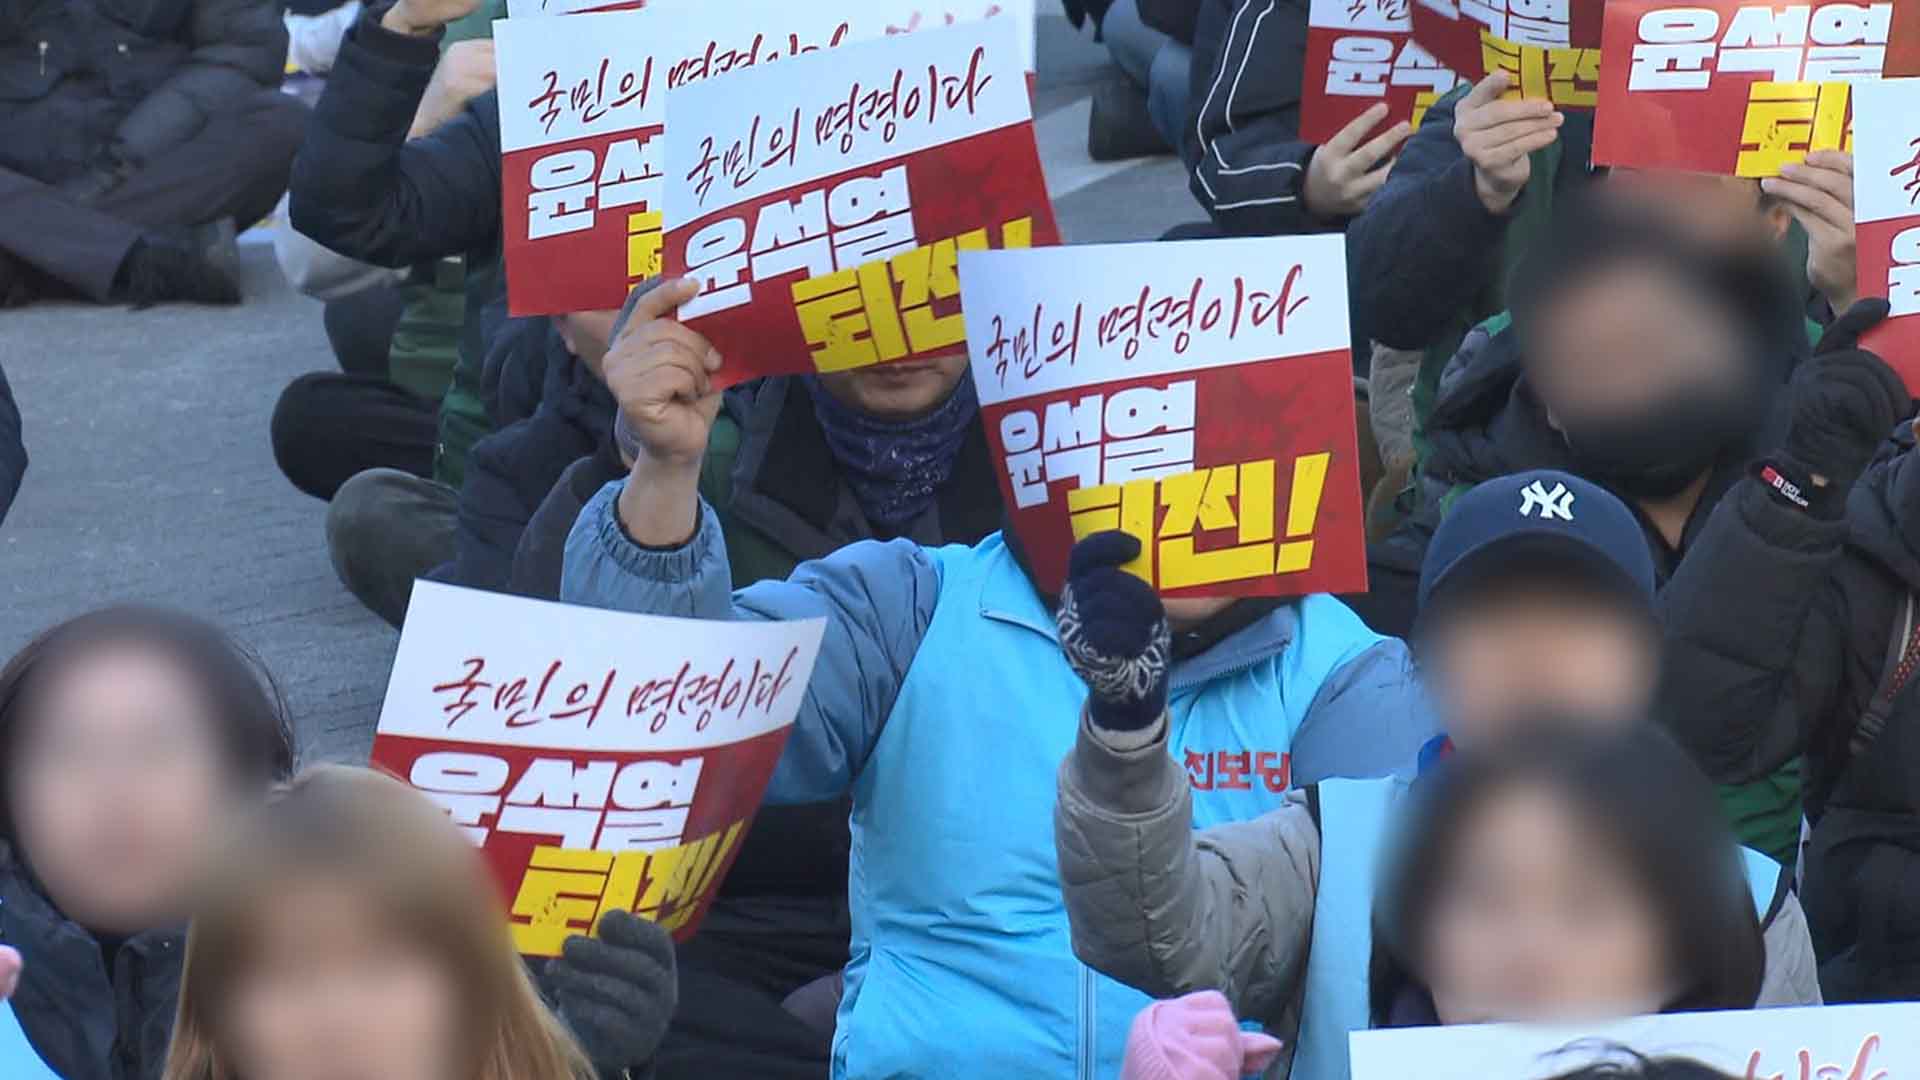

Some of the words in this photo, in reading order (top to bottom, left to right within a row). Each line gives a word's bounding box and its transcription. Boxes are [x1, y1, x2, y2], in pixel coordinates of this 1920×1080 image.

[529, 57, 654, 135] 국민의
[1629, 2, 1894, 92] 윤석열
[686, 108, 800, 206] 국민의
[815, 46, 991, 155] 명령이다
[677, 164, 917, 321] 윤석열
[987, 303, 1082, 389] 국민의
[1099, 264, 1309, 362] 명령이다
[1000, 379, 1197, 509] 윤석열
[433, 657, 616, 729] 국민의
[626, 645, 798, 733] 명령이다
[1184, 747, 1291, 794] 진보당
